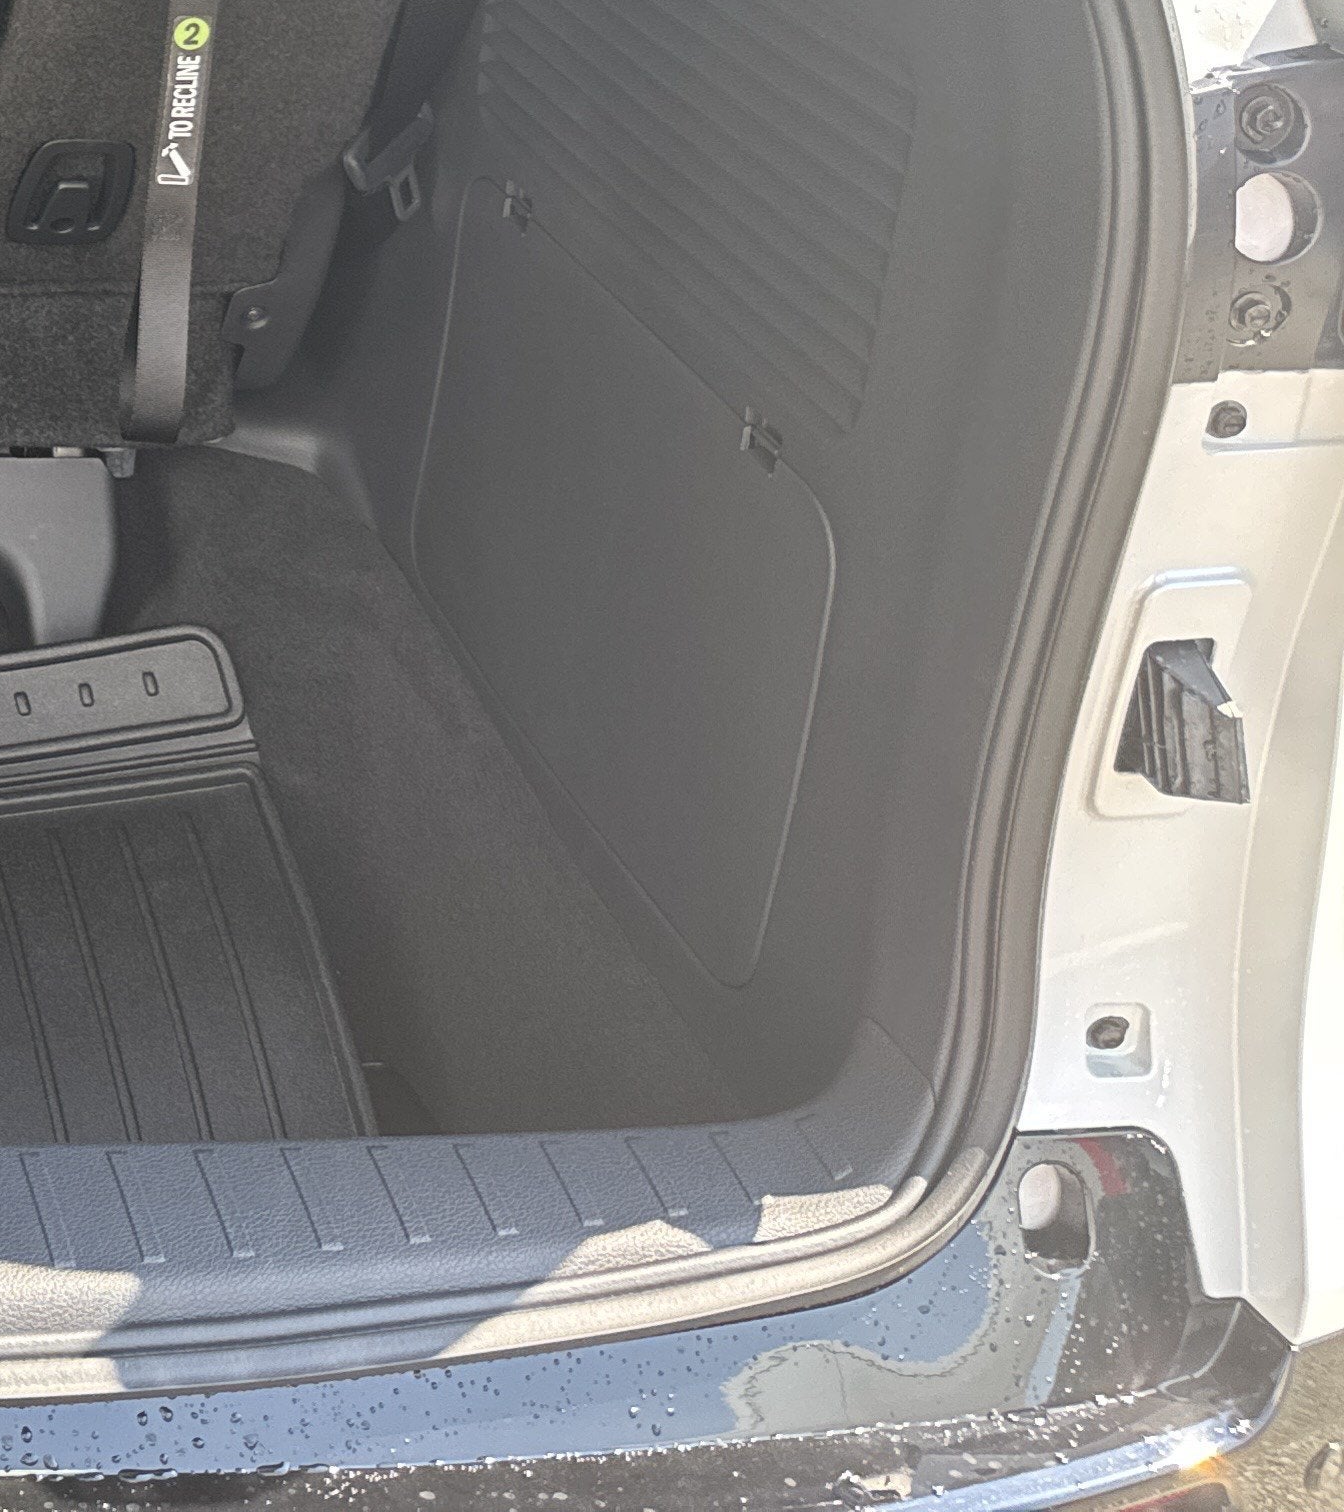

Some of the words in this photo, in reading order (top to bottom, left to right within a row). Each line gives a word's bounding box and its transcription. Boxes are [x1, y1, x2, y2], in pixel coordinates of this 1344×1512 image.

[183, 22, 200, 45] 2
[170, 55, 201, 118] RECLINE
[168, 120, 194, 140] TO
